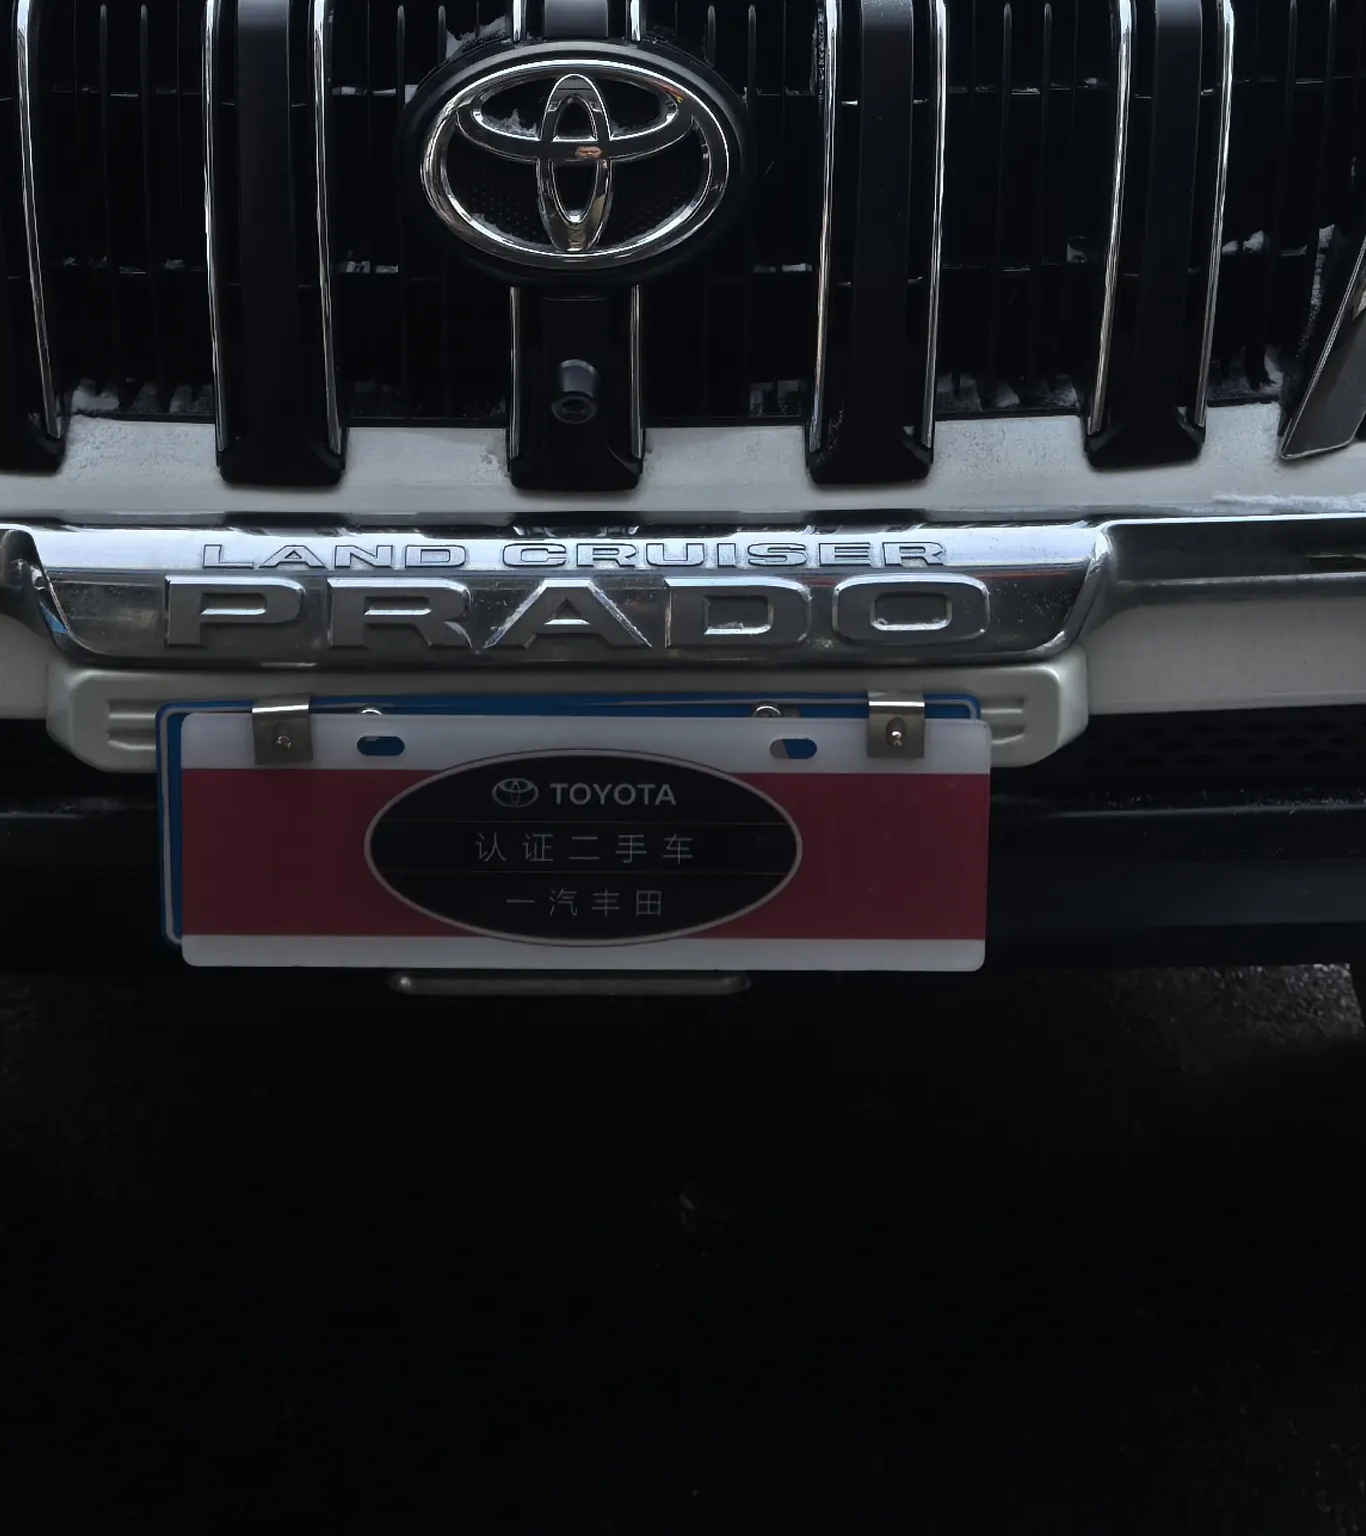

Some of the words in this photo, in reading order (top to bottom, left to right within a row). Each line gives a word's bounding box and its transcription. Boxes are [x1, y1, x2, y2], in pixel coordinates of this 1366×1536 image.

[202, 544, 469, 569] LAND
[502, 542, 947, 567] CRUISER
[165, 573, 991, 648] PRADO
[550, 783, 677, 805] TOYOTA
[475, 832, 694, 865] 认证二手车
[505, 888, 662, 916] 一汽丰田
